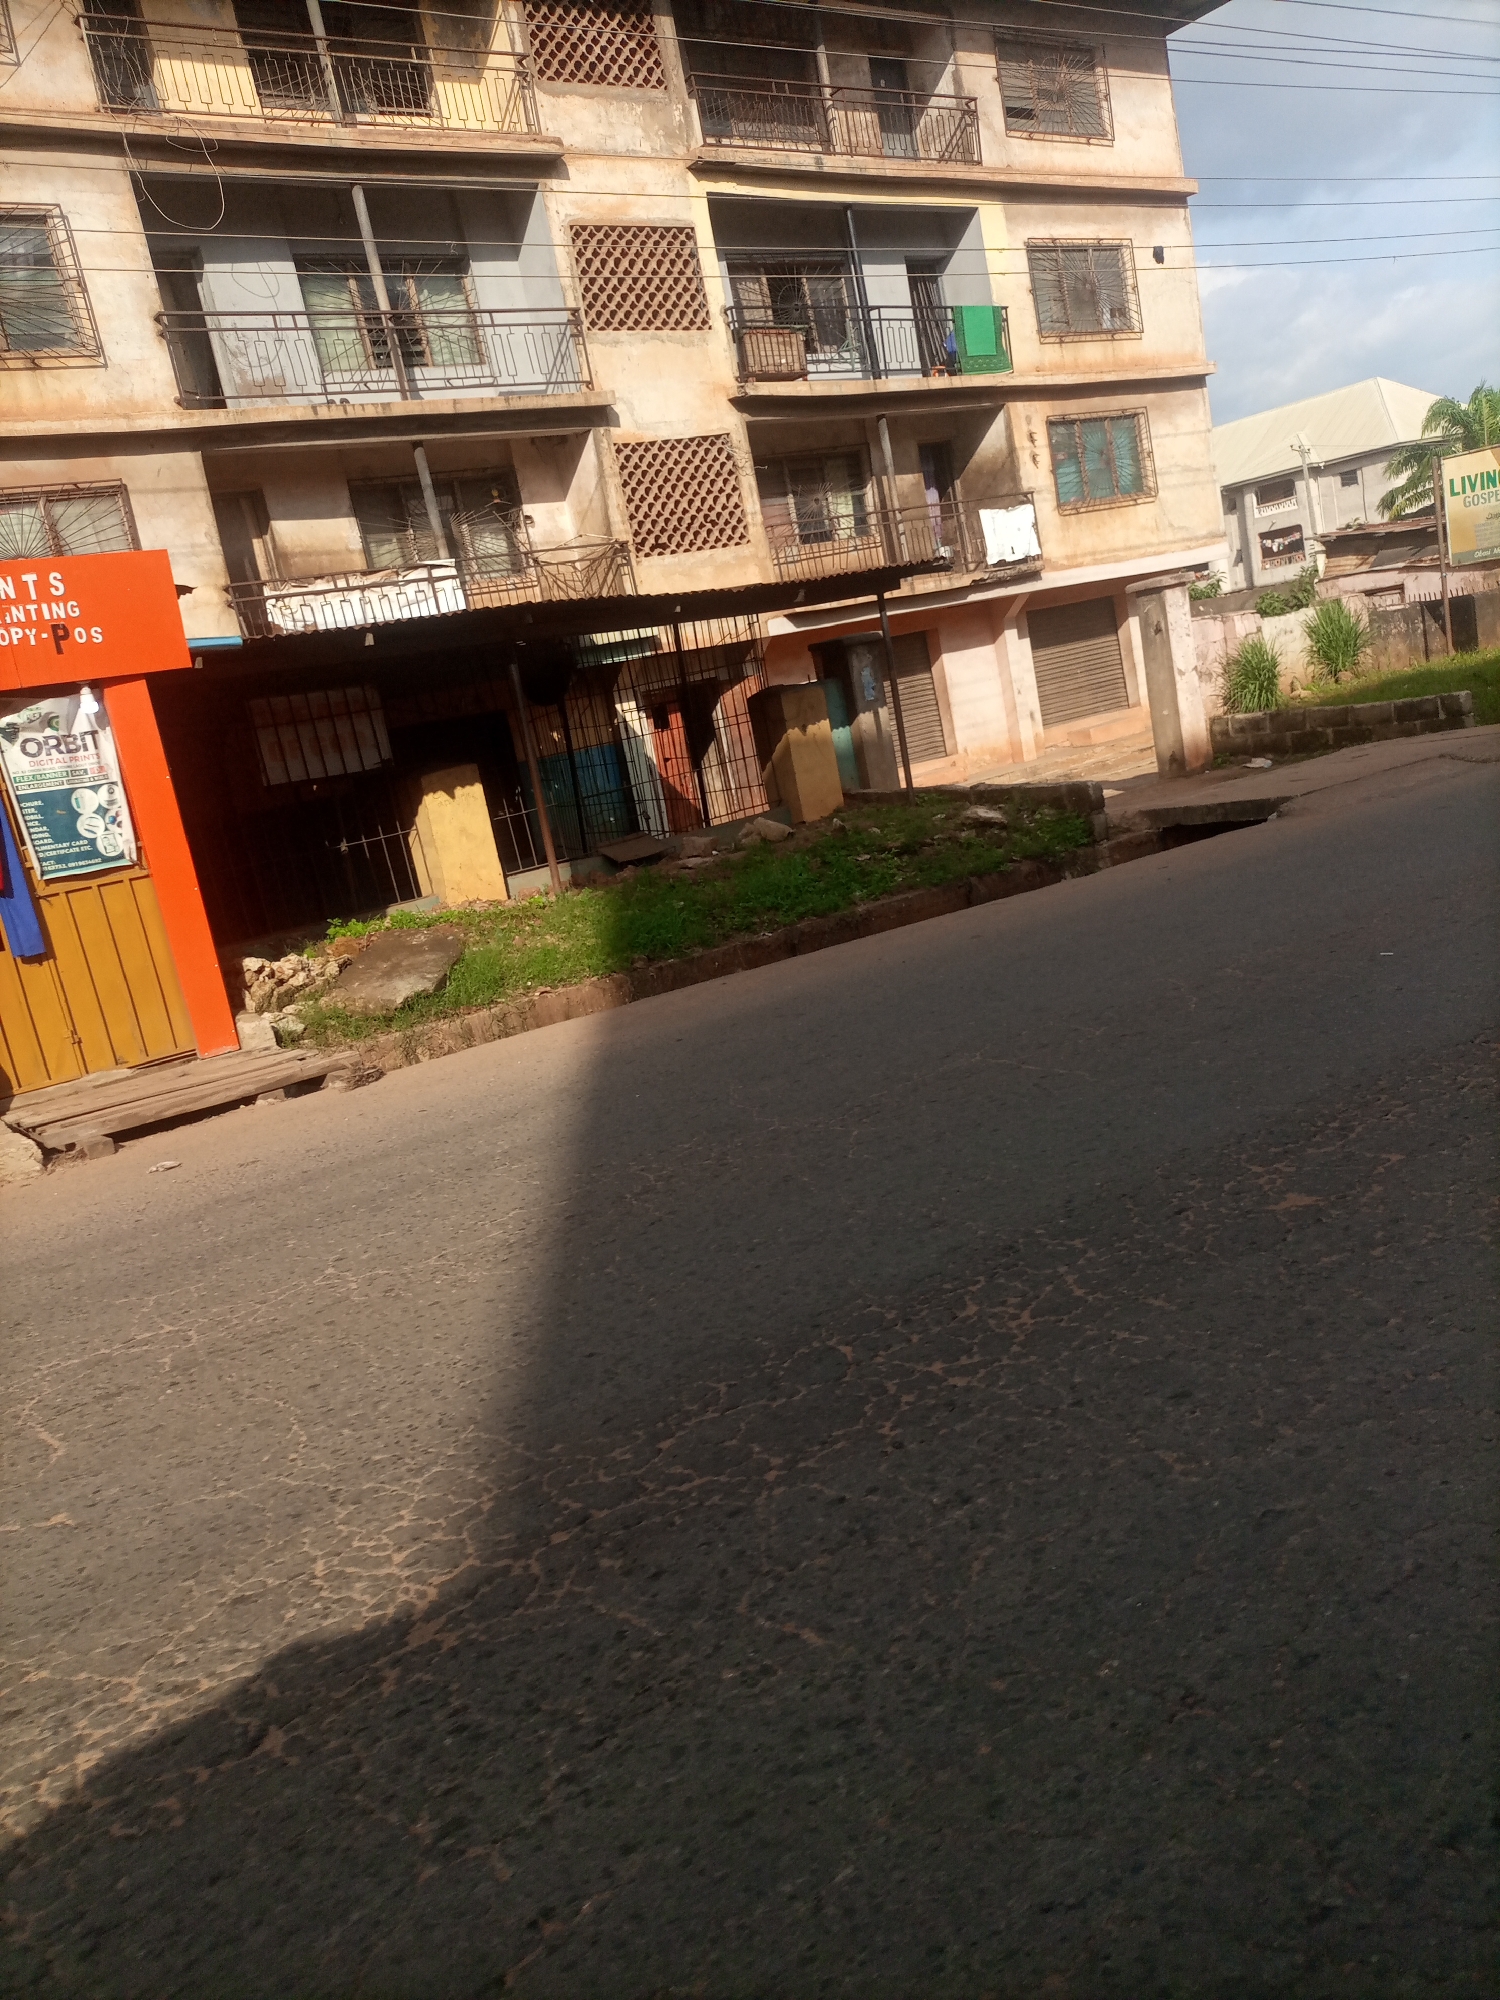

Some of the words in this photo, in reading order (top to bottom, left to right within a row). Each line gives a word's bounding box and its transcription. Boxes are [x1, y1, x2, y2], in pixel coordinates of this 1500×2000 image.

[1449, 469, 1500, 497] LIVIN
[0, 600, 80, 624] INTING
[20, 730, 99, 758] ORBIT
[28, 757, 68, 768] DIGITAL
[69, 753, 100, 762] PRINTS
[16, 771, 68, 783] FLEX/BANNER
[17, 781, 64, 791] ENLARGEMENT
